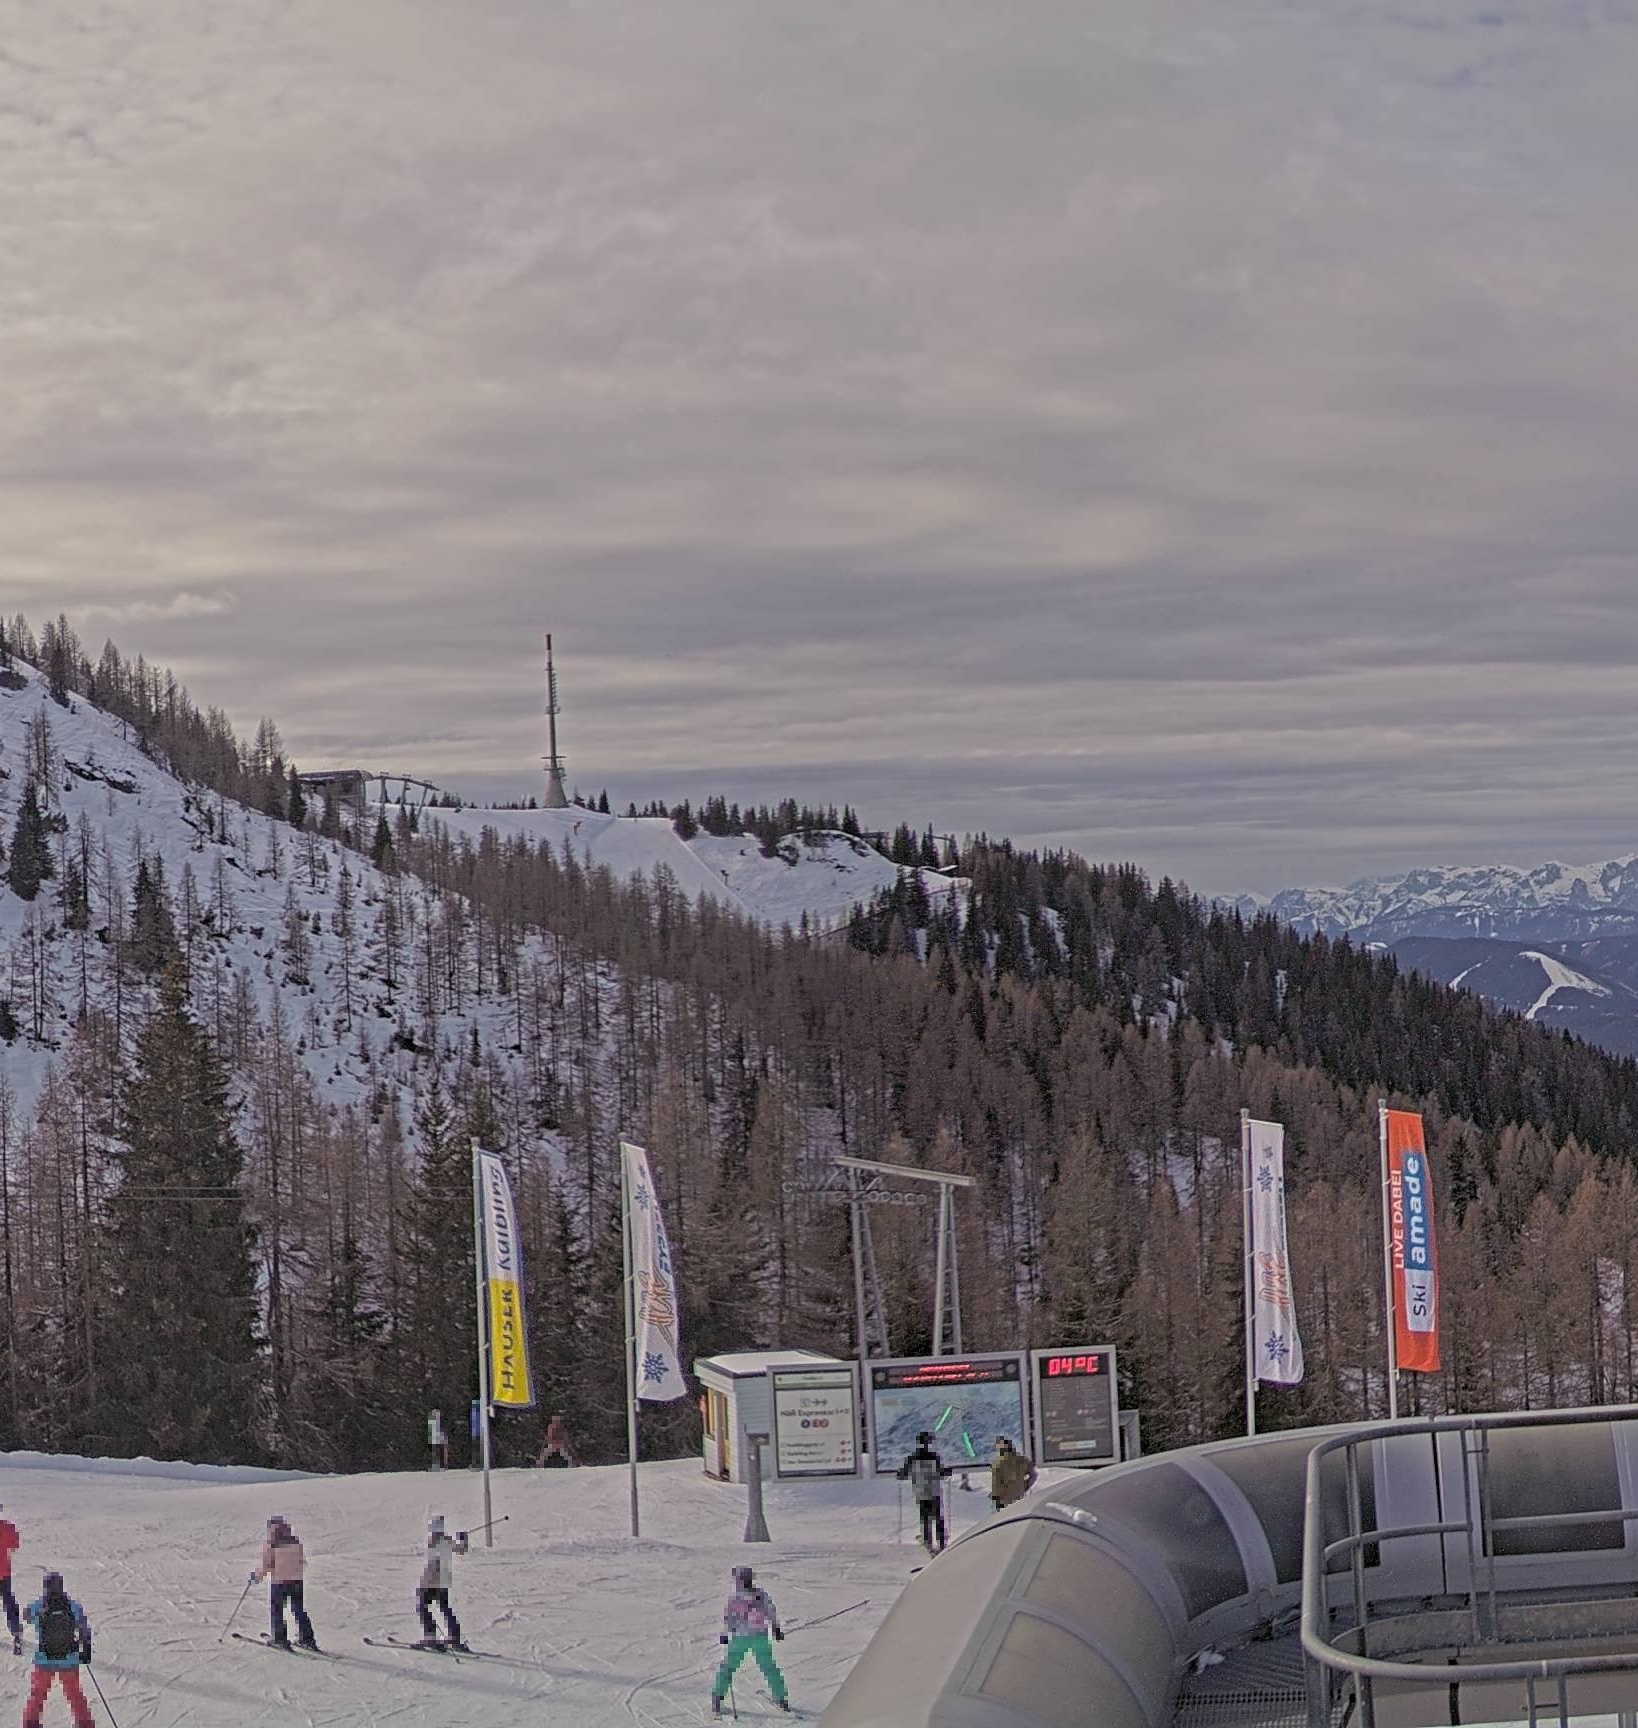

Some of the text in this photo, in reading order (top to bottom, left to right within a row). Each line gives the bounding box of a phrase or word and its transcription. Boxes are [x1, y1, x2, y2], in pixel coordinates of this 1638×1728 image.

[490, 1165, 511, 1271] Kaibling
[1390, 1169, 1405, 1269] LIVE DABEI
[501, 1289, 516, 1391] HAUSER
[1412, 1285, 1427, 1317] Ski
